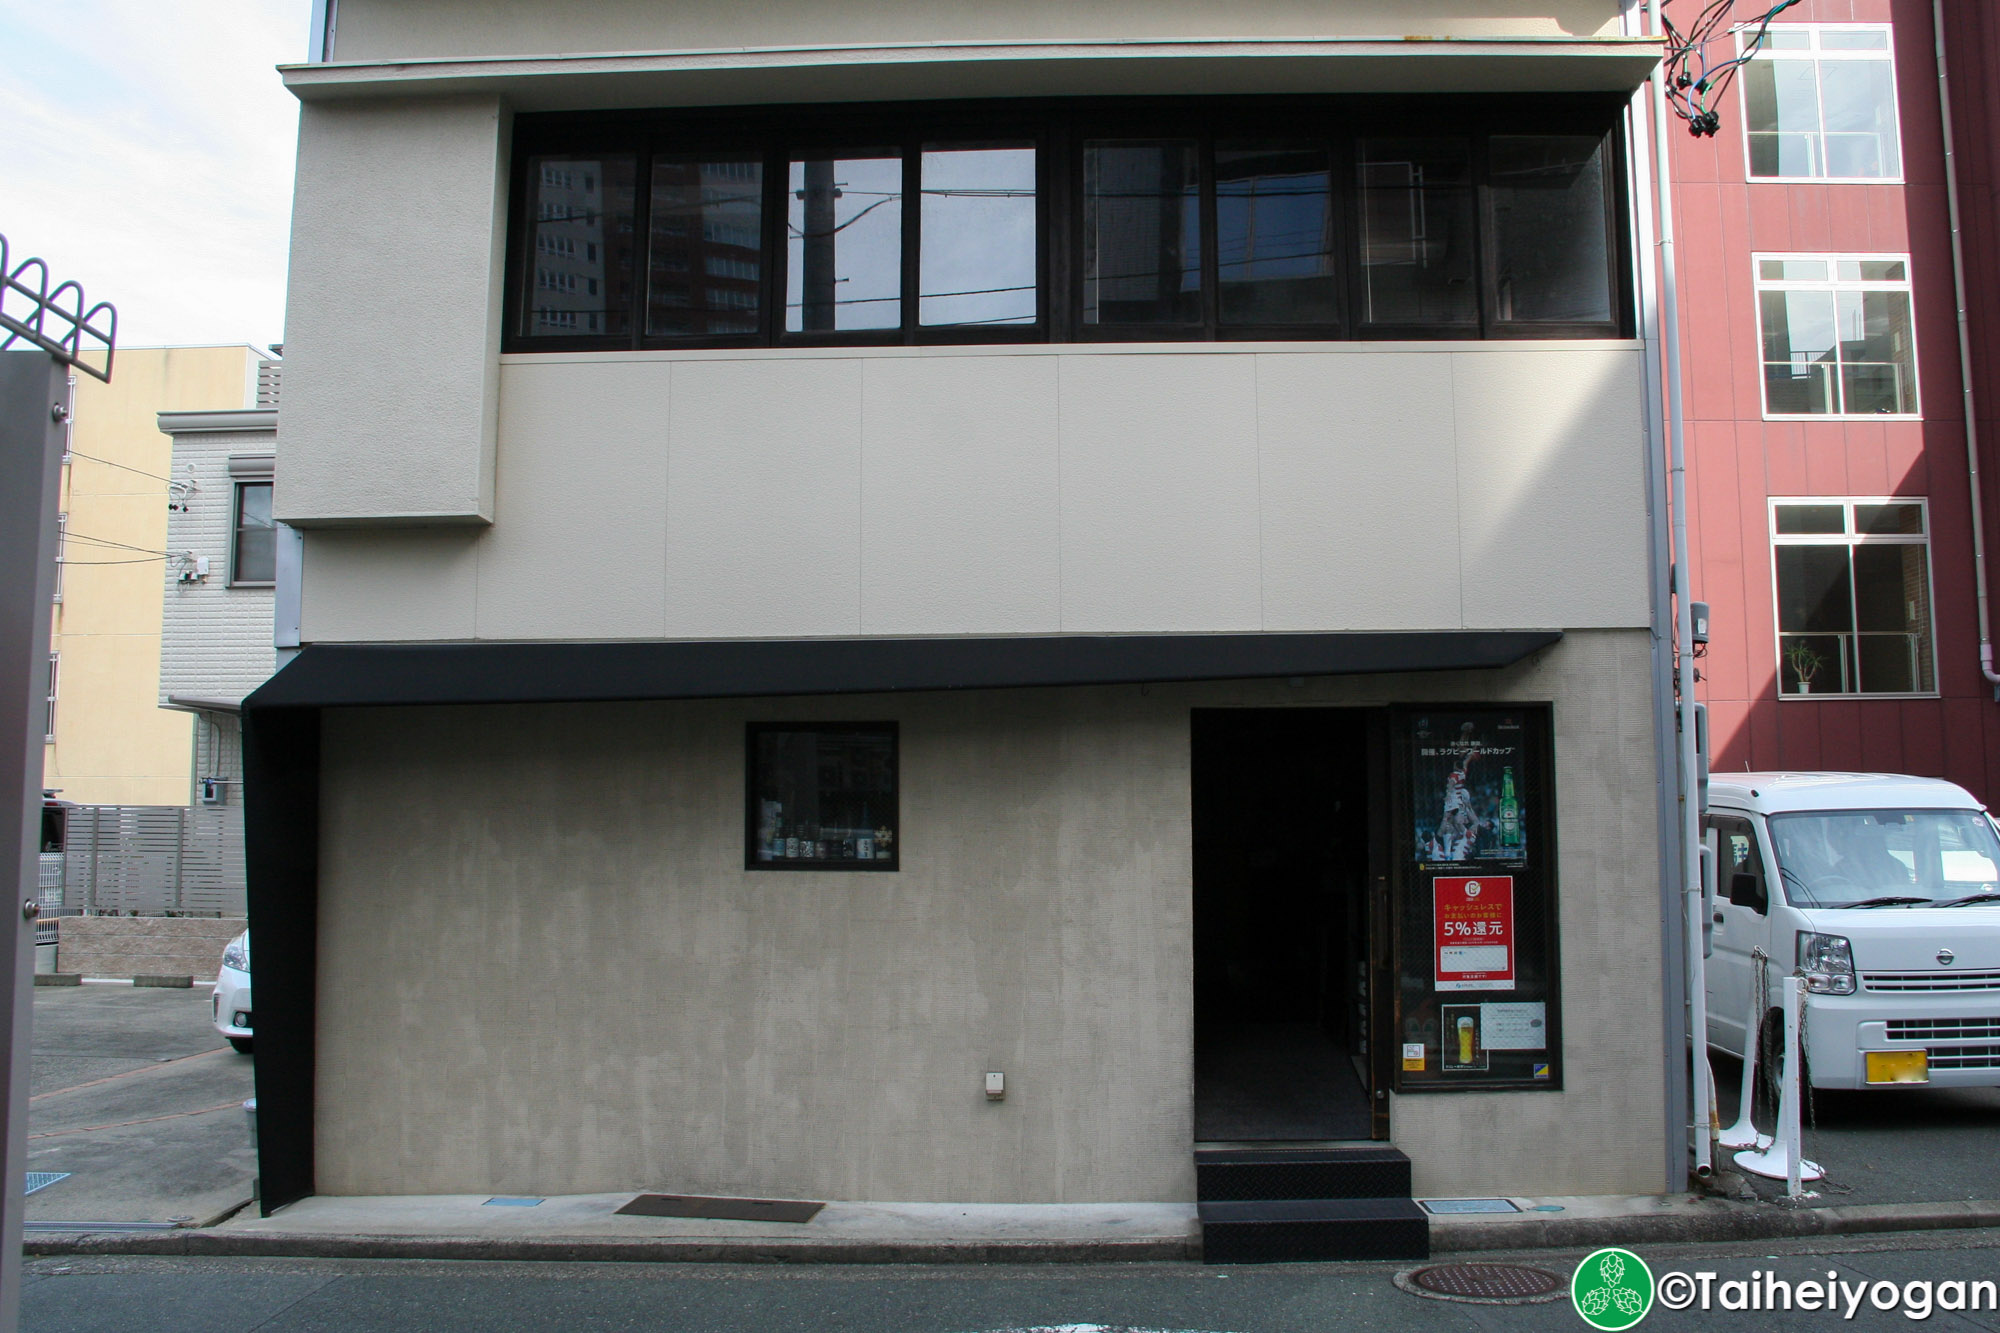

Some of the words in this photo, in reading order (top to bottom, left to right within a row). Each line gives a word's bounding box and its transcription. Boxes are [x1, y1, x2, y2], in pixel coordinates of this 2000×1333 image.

[1444, 903, 1503, 911] キャッシュレスで
[1444, 921, 1503, 936] 5%還元
